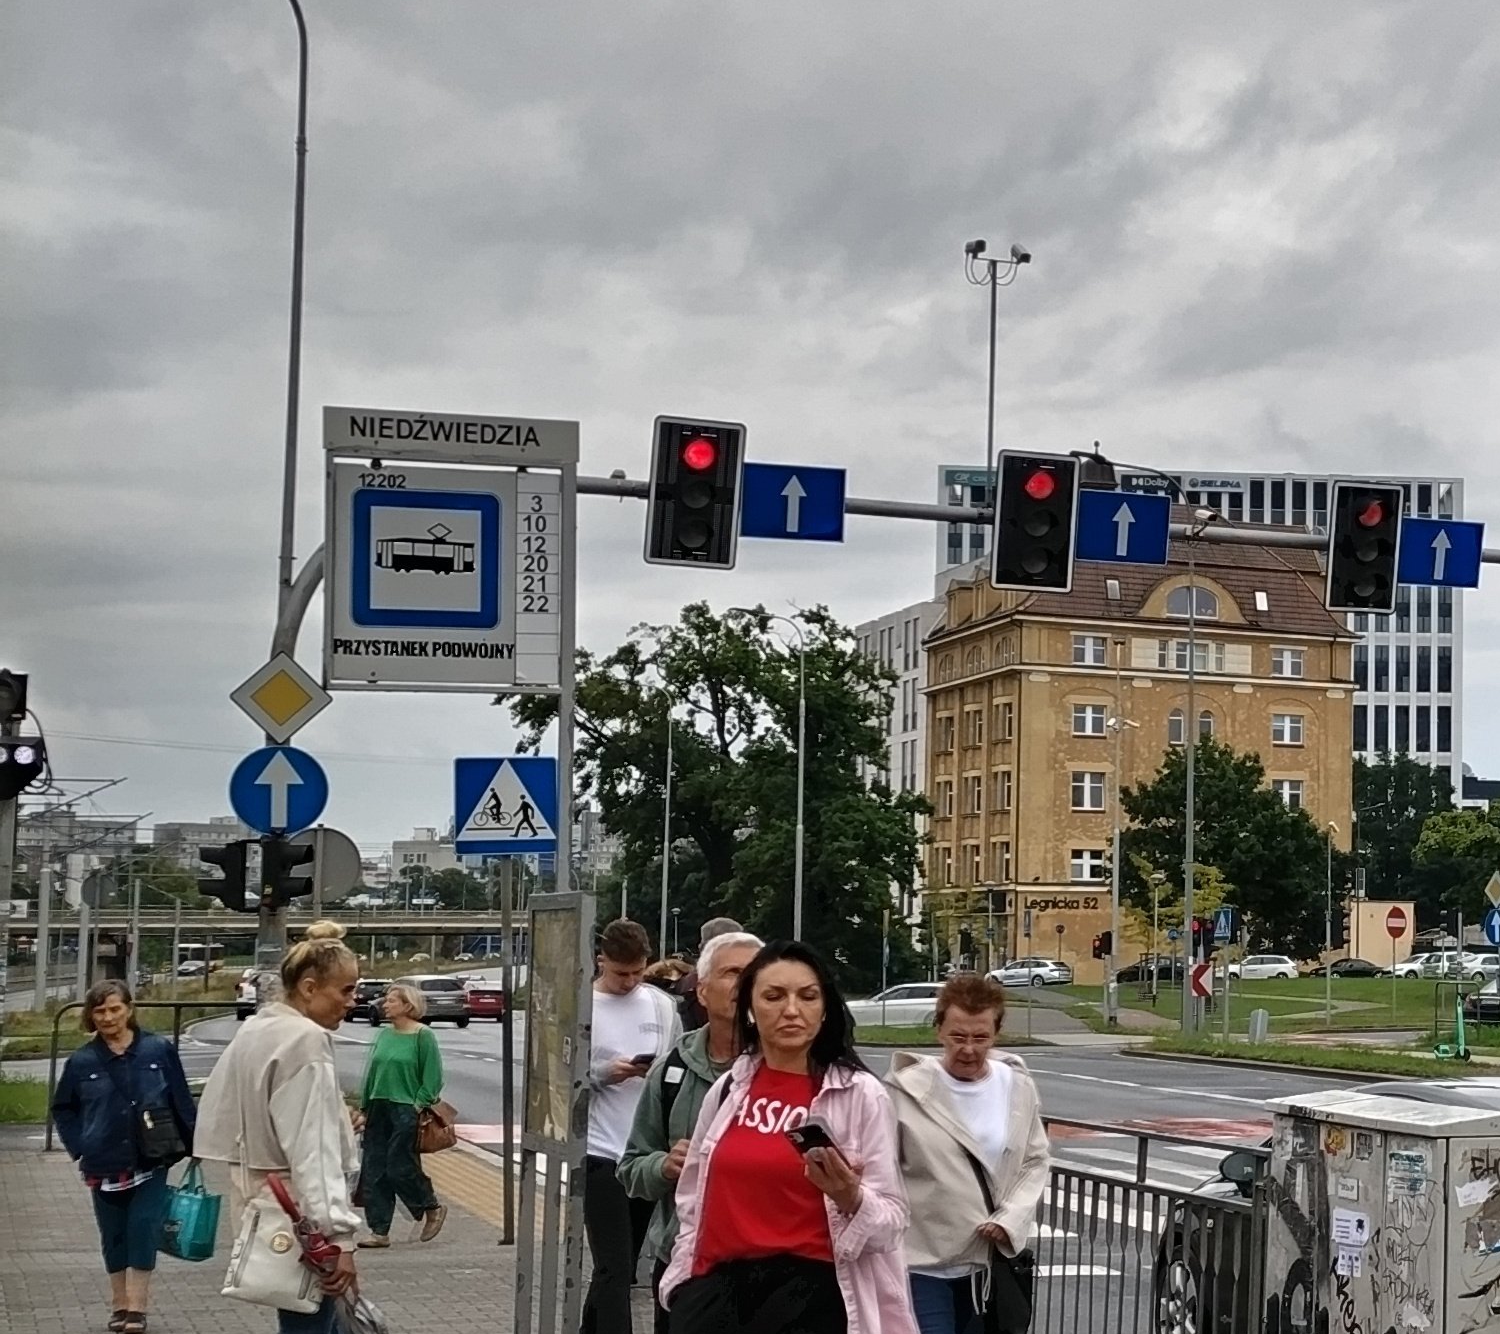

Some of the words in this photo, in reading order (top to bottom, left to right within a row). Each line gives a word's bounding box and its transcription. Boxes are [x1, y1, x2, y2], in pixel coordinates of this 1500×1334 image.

[350, 415, 540, 447] NIEDŹWIEDZIA
[359, 473, 406, 489] 12202
[1144, 478, 1169, 488] Dolby
[530, 495, 543, 513] 3
[522, 515, 547, 532] 10
[522, 535, 547, 553] 12
[522, 555, 549, 573] 20
[522, 575, 547, 593] 21
[522, 594, 549, 613] 22
[333, 638, 428, 658] PRZYSTANEK
[1024, 897, 1079, 911] Legnicka
[1083, 897, 1098, 910] 52
[735, 1094, 808, 1135] ASSIO
